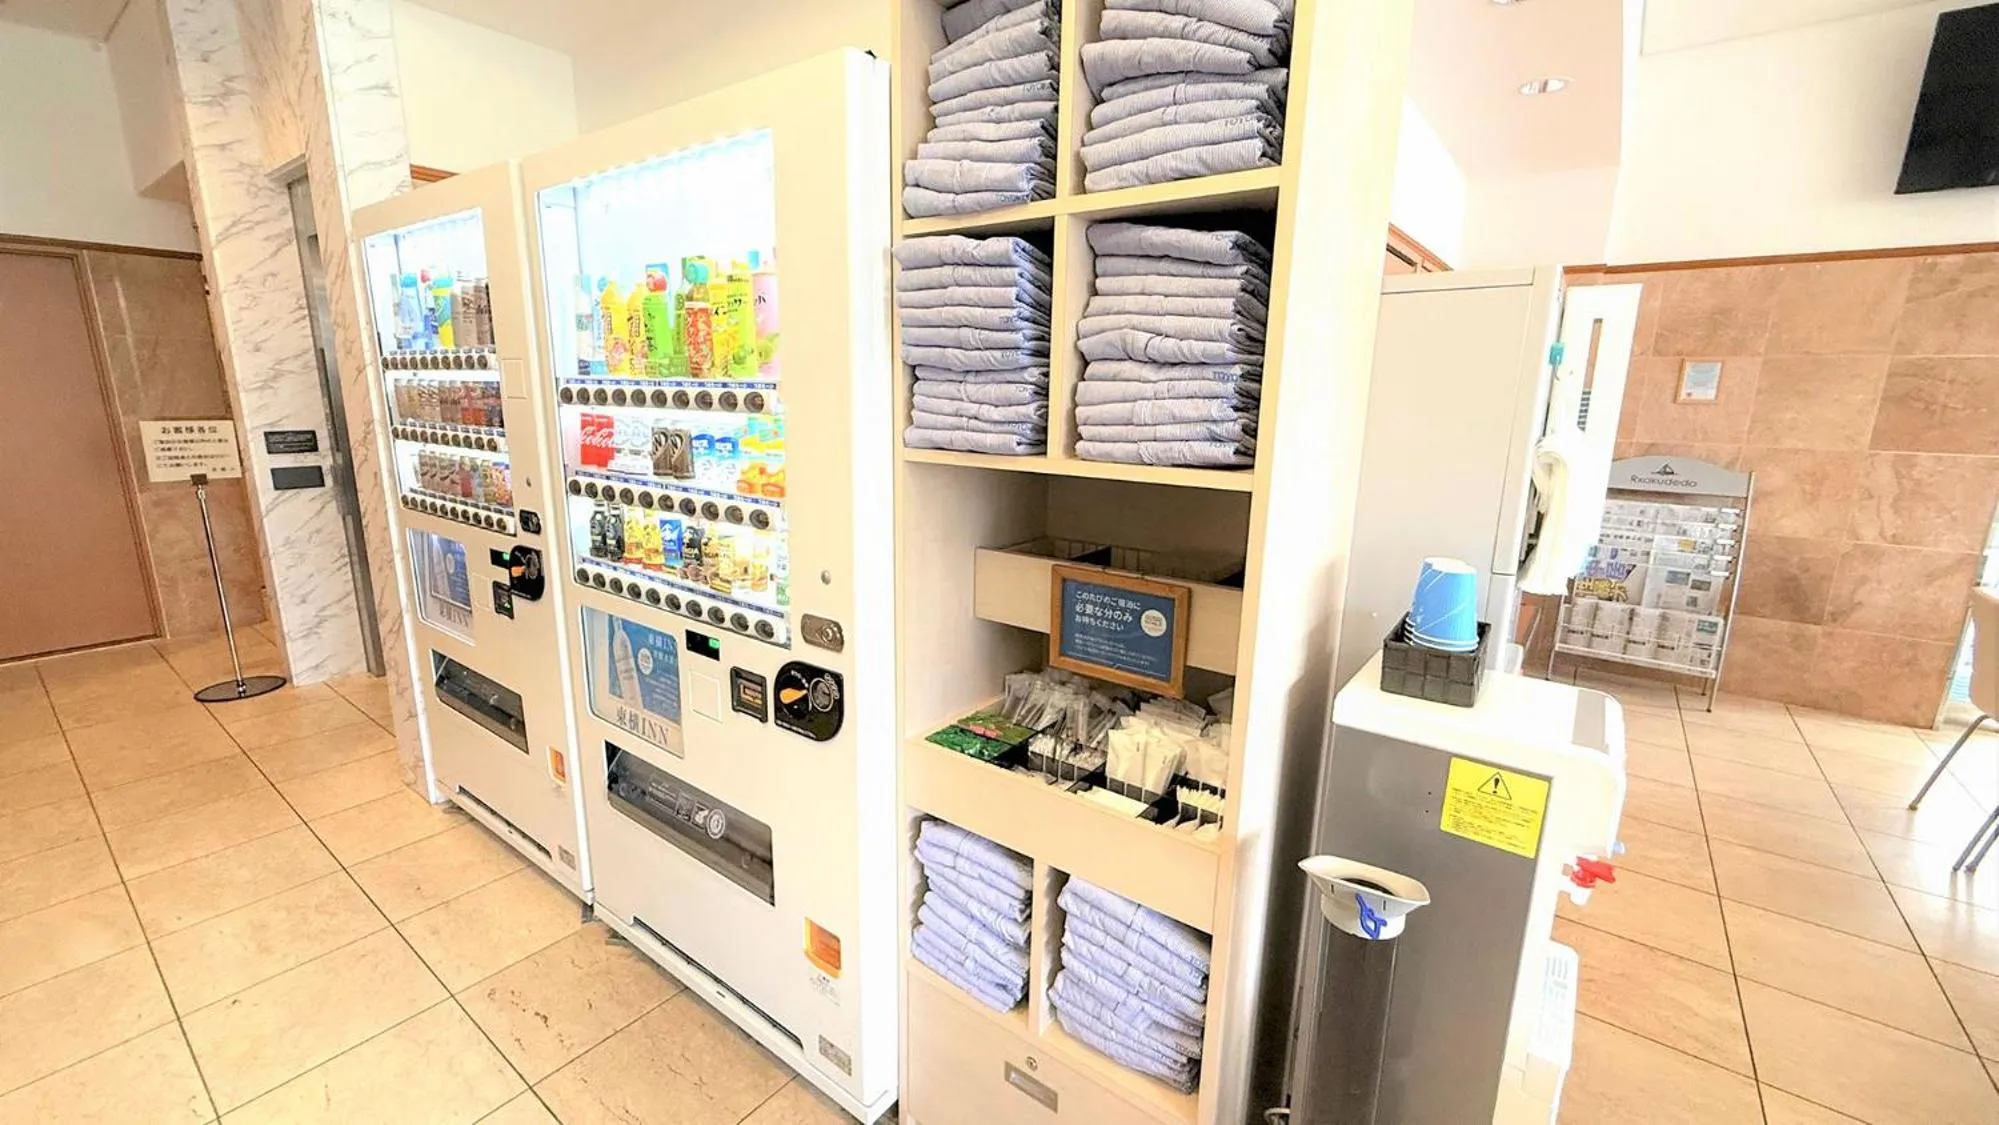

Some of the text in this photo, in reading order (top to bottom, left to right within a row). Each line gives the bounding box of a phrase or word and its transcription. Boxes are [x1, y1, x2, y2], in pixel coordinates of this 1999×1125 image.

[1075, 590, 1141, 610] このたびのご宿泊に
[1074, 602, 1133, 623] 必要な分のみ
[1073, 615, 1124, 631] お持ちください
